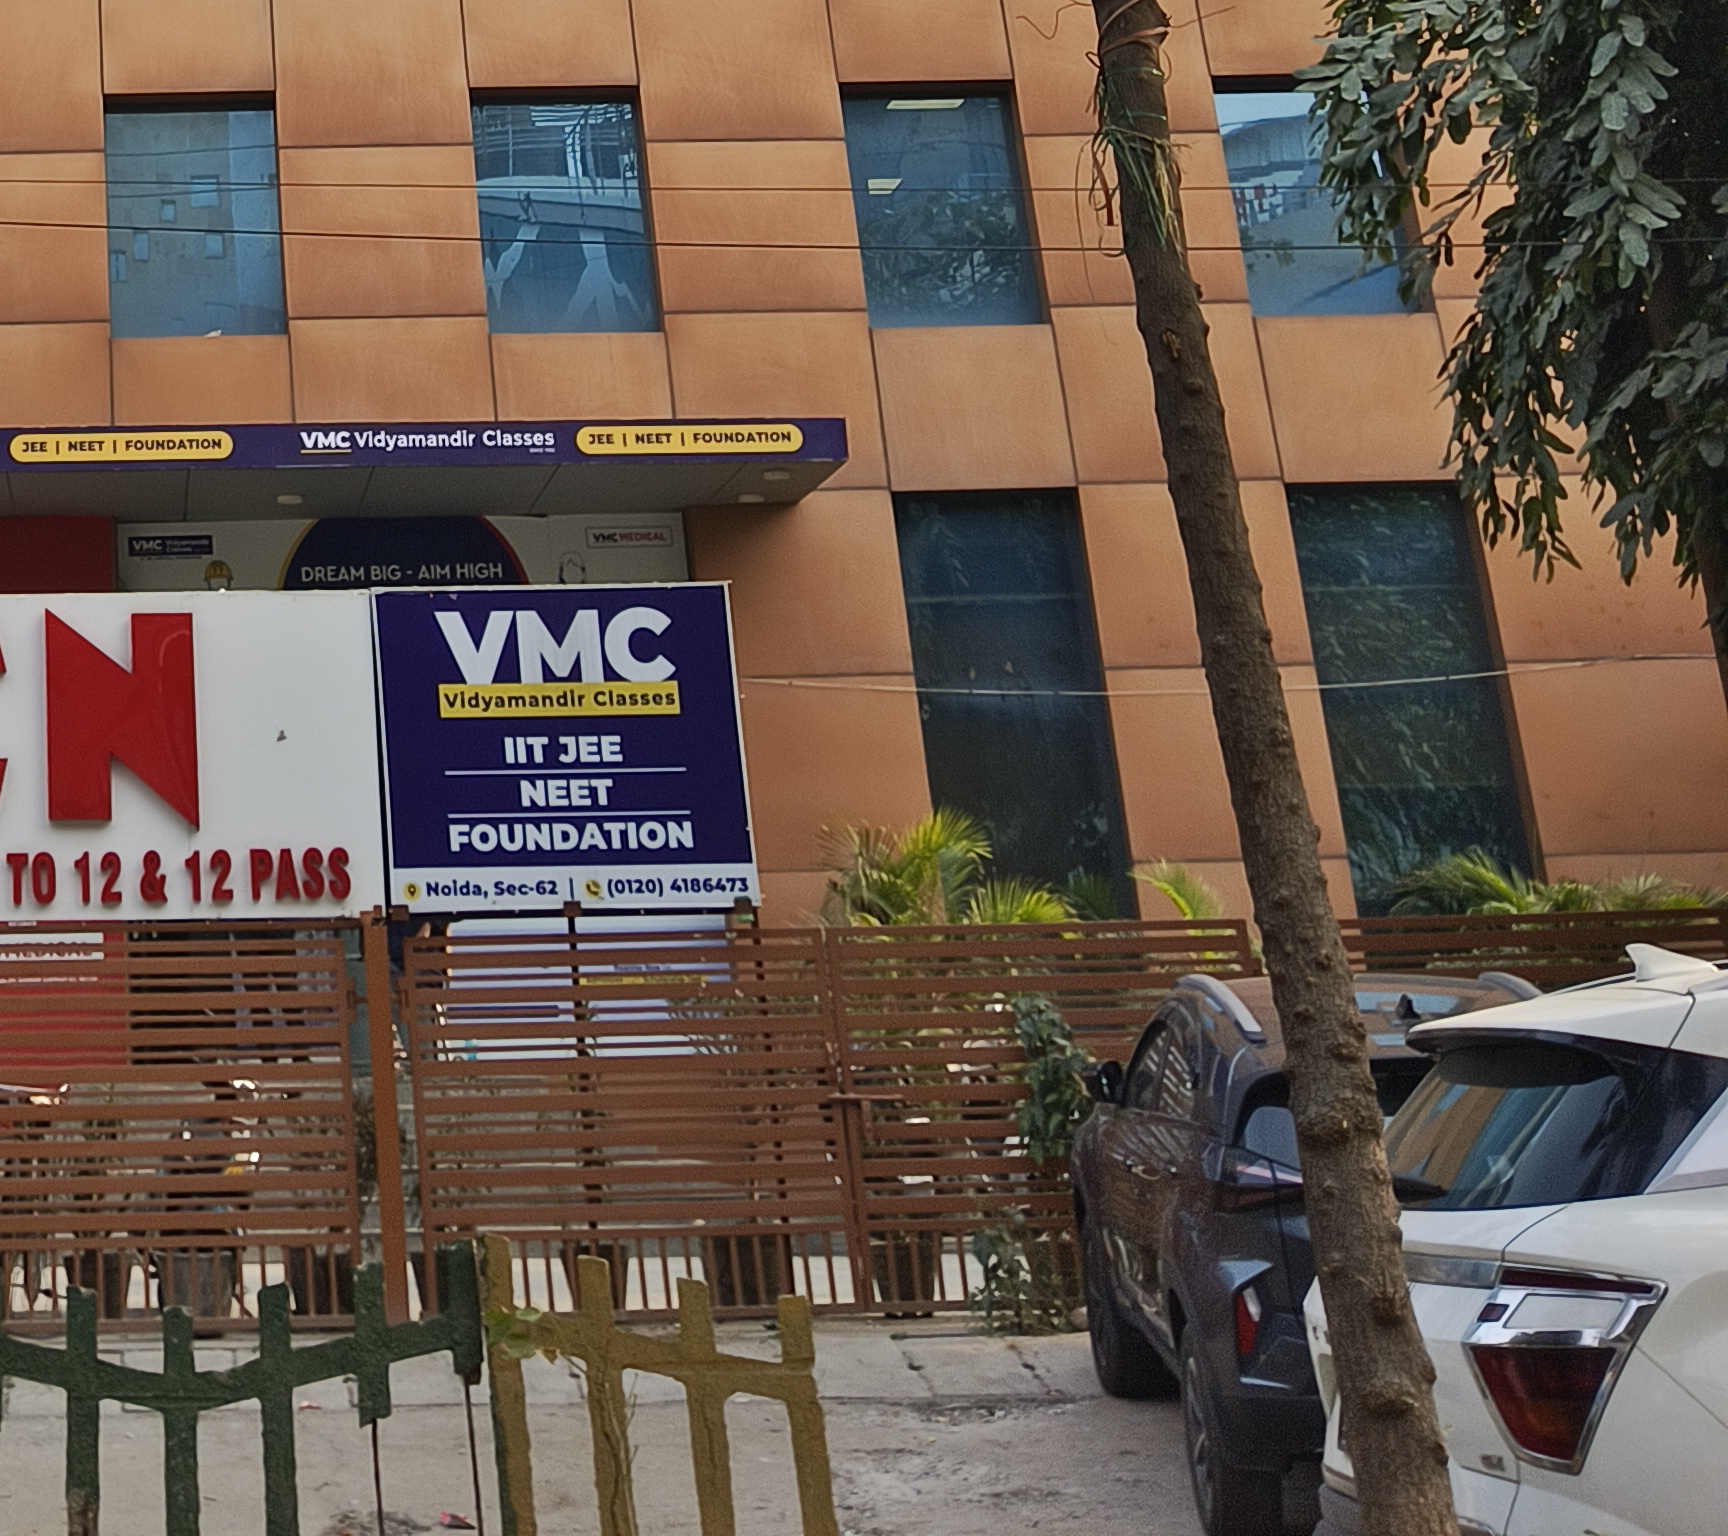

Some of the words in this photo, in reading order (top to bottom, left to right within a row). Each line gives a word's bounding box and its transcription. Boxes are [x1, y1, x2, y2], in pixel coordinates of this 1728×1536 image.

[22, 441, 48, 453] JEE
[68, 440, 104, 453] NEET
[125, 438, 222, 452] FOUNDATION
[301, 431, 351, 449] VMC
[354, 429, 475, 452] Vidyamandir
[483, 429, 555, 447] Classes
[588, 433, 615, 446] JEE
[635, 432, 672, 445] NEET
[693, 430, 792, 444] FOUNDATION
[132, 540, 163, 550] VMC
[301, 566, 365, 582] DREAM
[371, 565, 402, 581] BIG
[418, 564, 451, 580] AIM
[456, 563, 502, 579] HIGH
[434, 607, 676, 684] VMC
[444, 688, 585, 712] Vidyamandir
[594, 688, 675, 706] Classes
[504, 737, 548, 764] IIT
[559, 735, 623, 762] JEE
[520, 779, 613, 806] NEET
[449, 821, 694, 852] FOUNDATION
[6, 852, 56, 905] TO
[74, 851, 122, 904] 12
[139, 850, 168, 904] &
[185, 849, 234, 903] 12
[250, 847, 351, 902] PASS
[426, 880, 489, 899] Noida,
[494, 880, 558, 897] Sec-62
[607, 878, 663, 898] (0120)
[670, 877, 749, 893] 4186473
